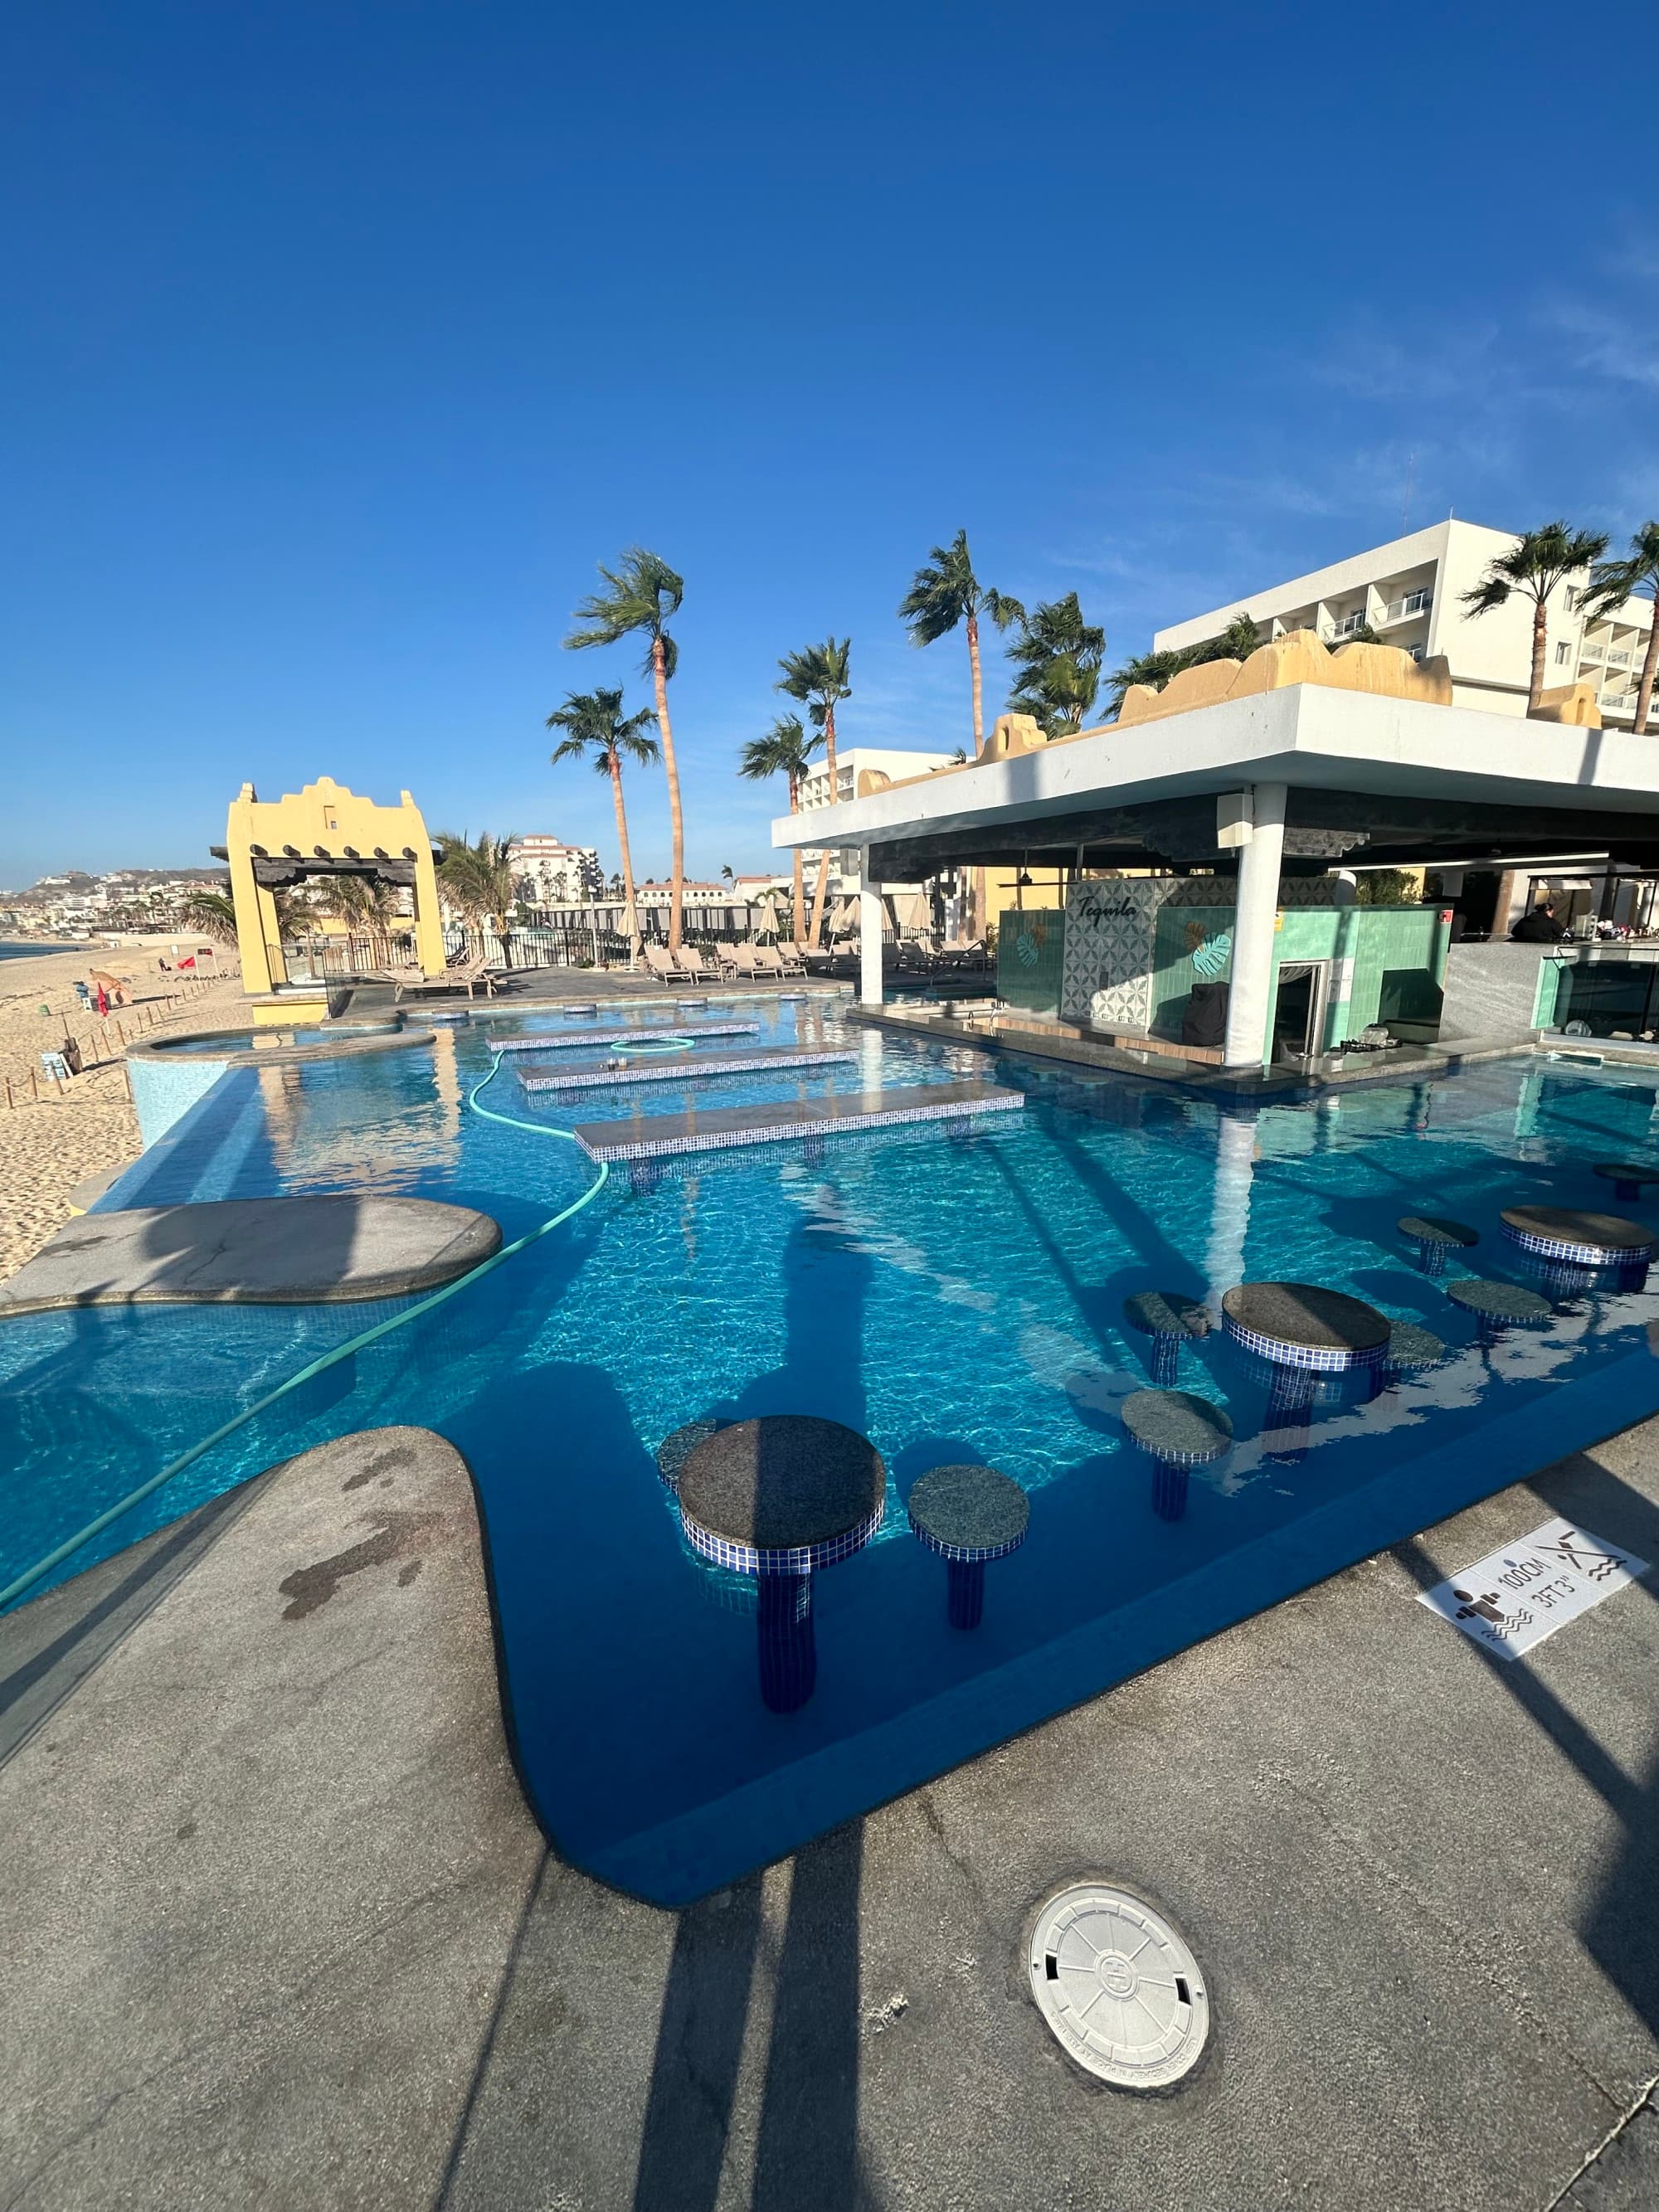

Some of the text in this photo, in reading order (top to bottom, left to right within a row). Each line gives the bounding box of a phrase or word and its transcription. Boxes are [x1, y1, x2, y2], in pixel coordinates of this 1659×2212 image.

[1079, 896, 1137, 926] Tequila
[1498, 1558, 1552, 1589] 100CM
[1531, 1585, 1564, 1607] 3FT
